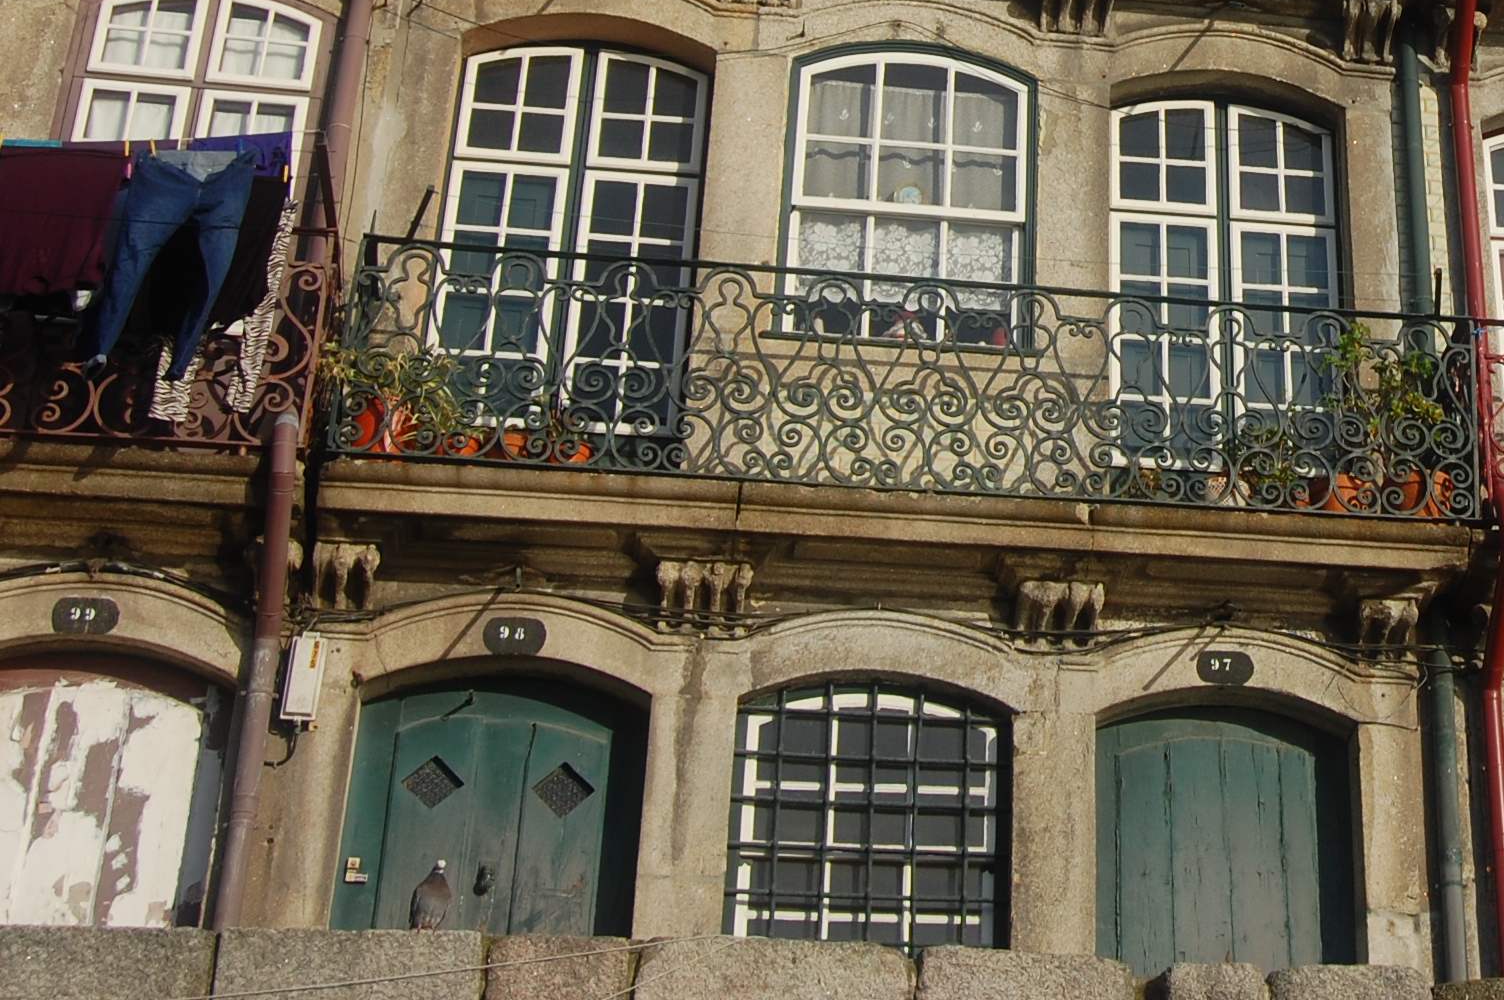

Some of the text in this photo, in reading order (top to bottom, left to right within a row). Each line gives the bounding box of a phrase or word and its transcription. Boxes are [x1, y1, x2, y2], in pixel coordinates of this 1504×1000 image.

[70, 607, 97, 621] 99
[499, 625, 525, 640] 98
[1210, 658, 1232, 671] 97
